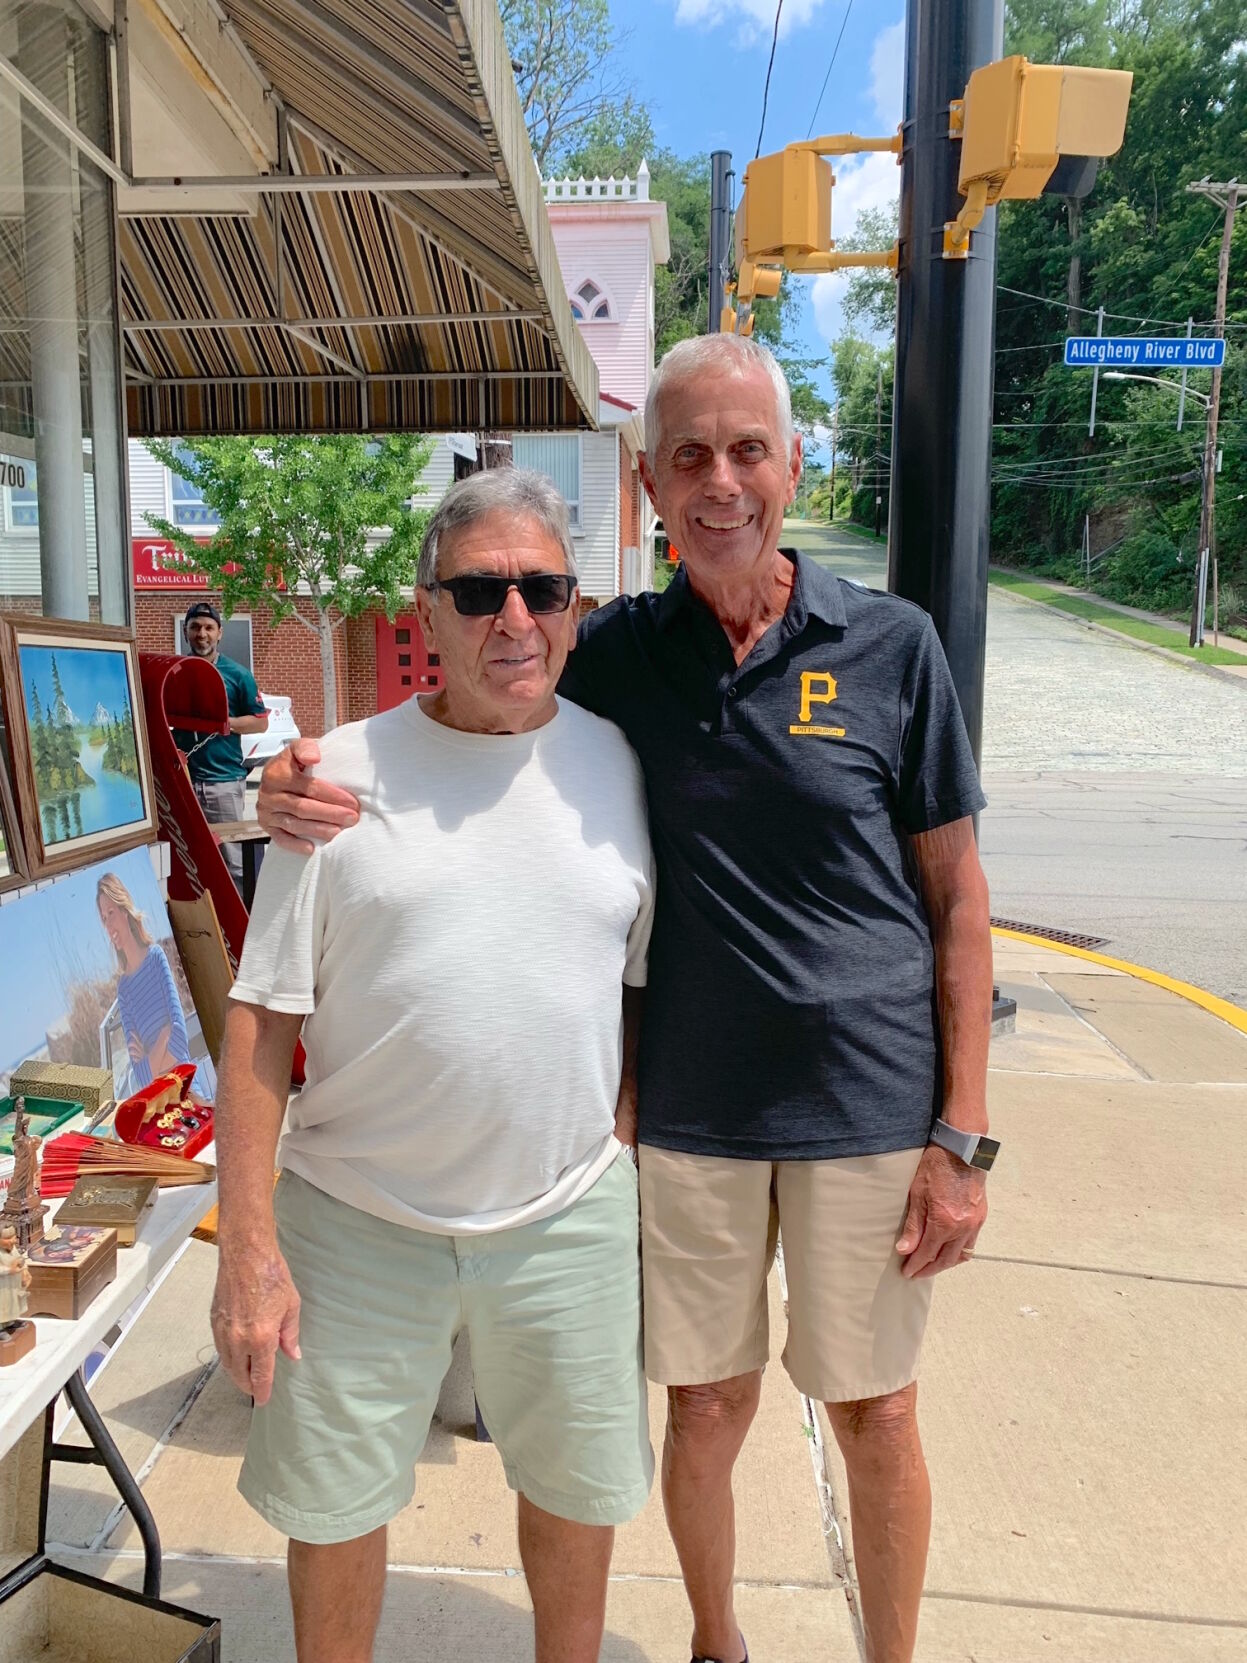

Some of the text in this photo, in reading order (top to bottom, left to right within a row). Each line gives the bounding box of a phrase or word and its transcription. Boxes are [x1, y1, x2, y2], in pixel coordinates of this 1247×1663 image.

[1070, 341, 1216, 362] Allegheny River Blvd
[136, 574, 192, 583] EVANGELICAL
[799, 671, 838, 722] P
[796, 727, 839, 735] PITTSBURGH
